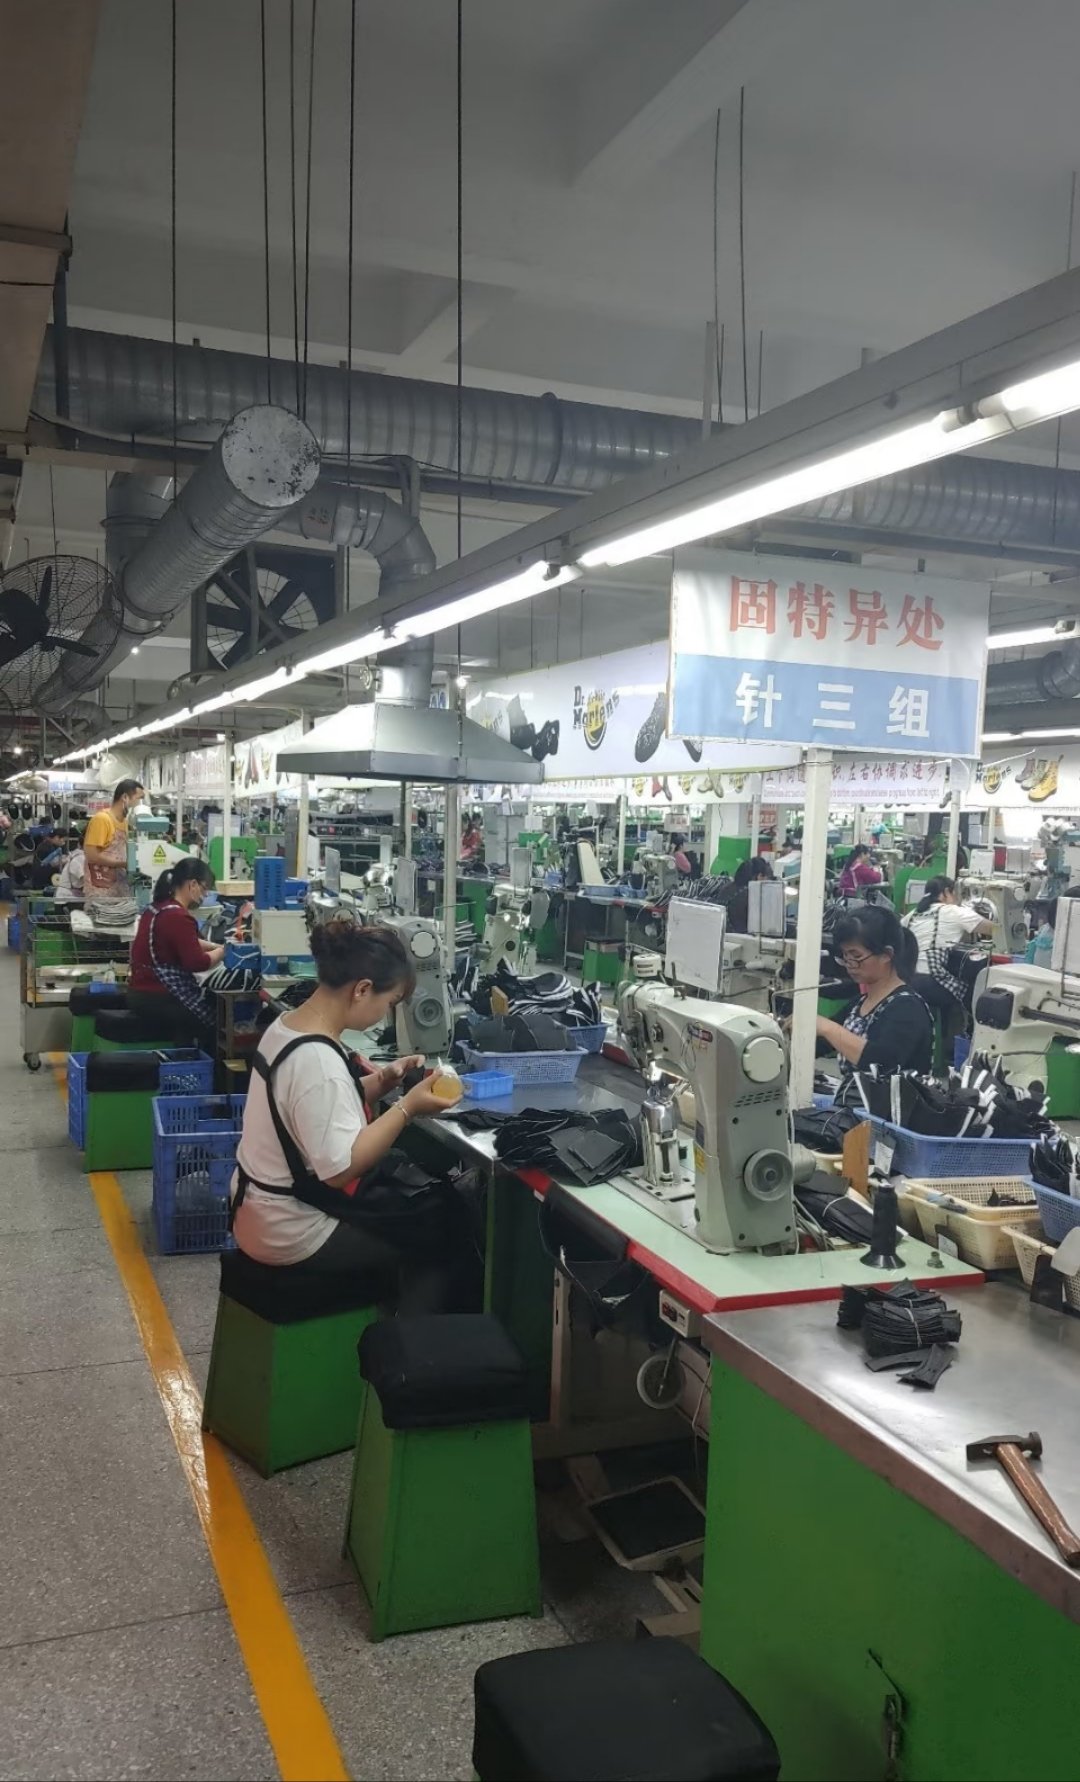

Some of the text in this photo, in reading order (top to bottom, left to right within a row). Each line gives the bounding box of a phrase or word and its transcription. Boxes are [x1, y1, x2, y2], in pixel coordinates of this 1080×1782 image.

[728, 575, 945, 651] 固特异处
[735, 672, 930, 738] 针三组
